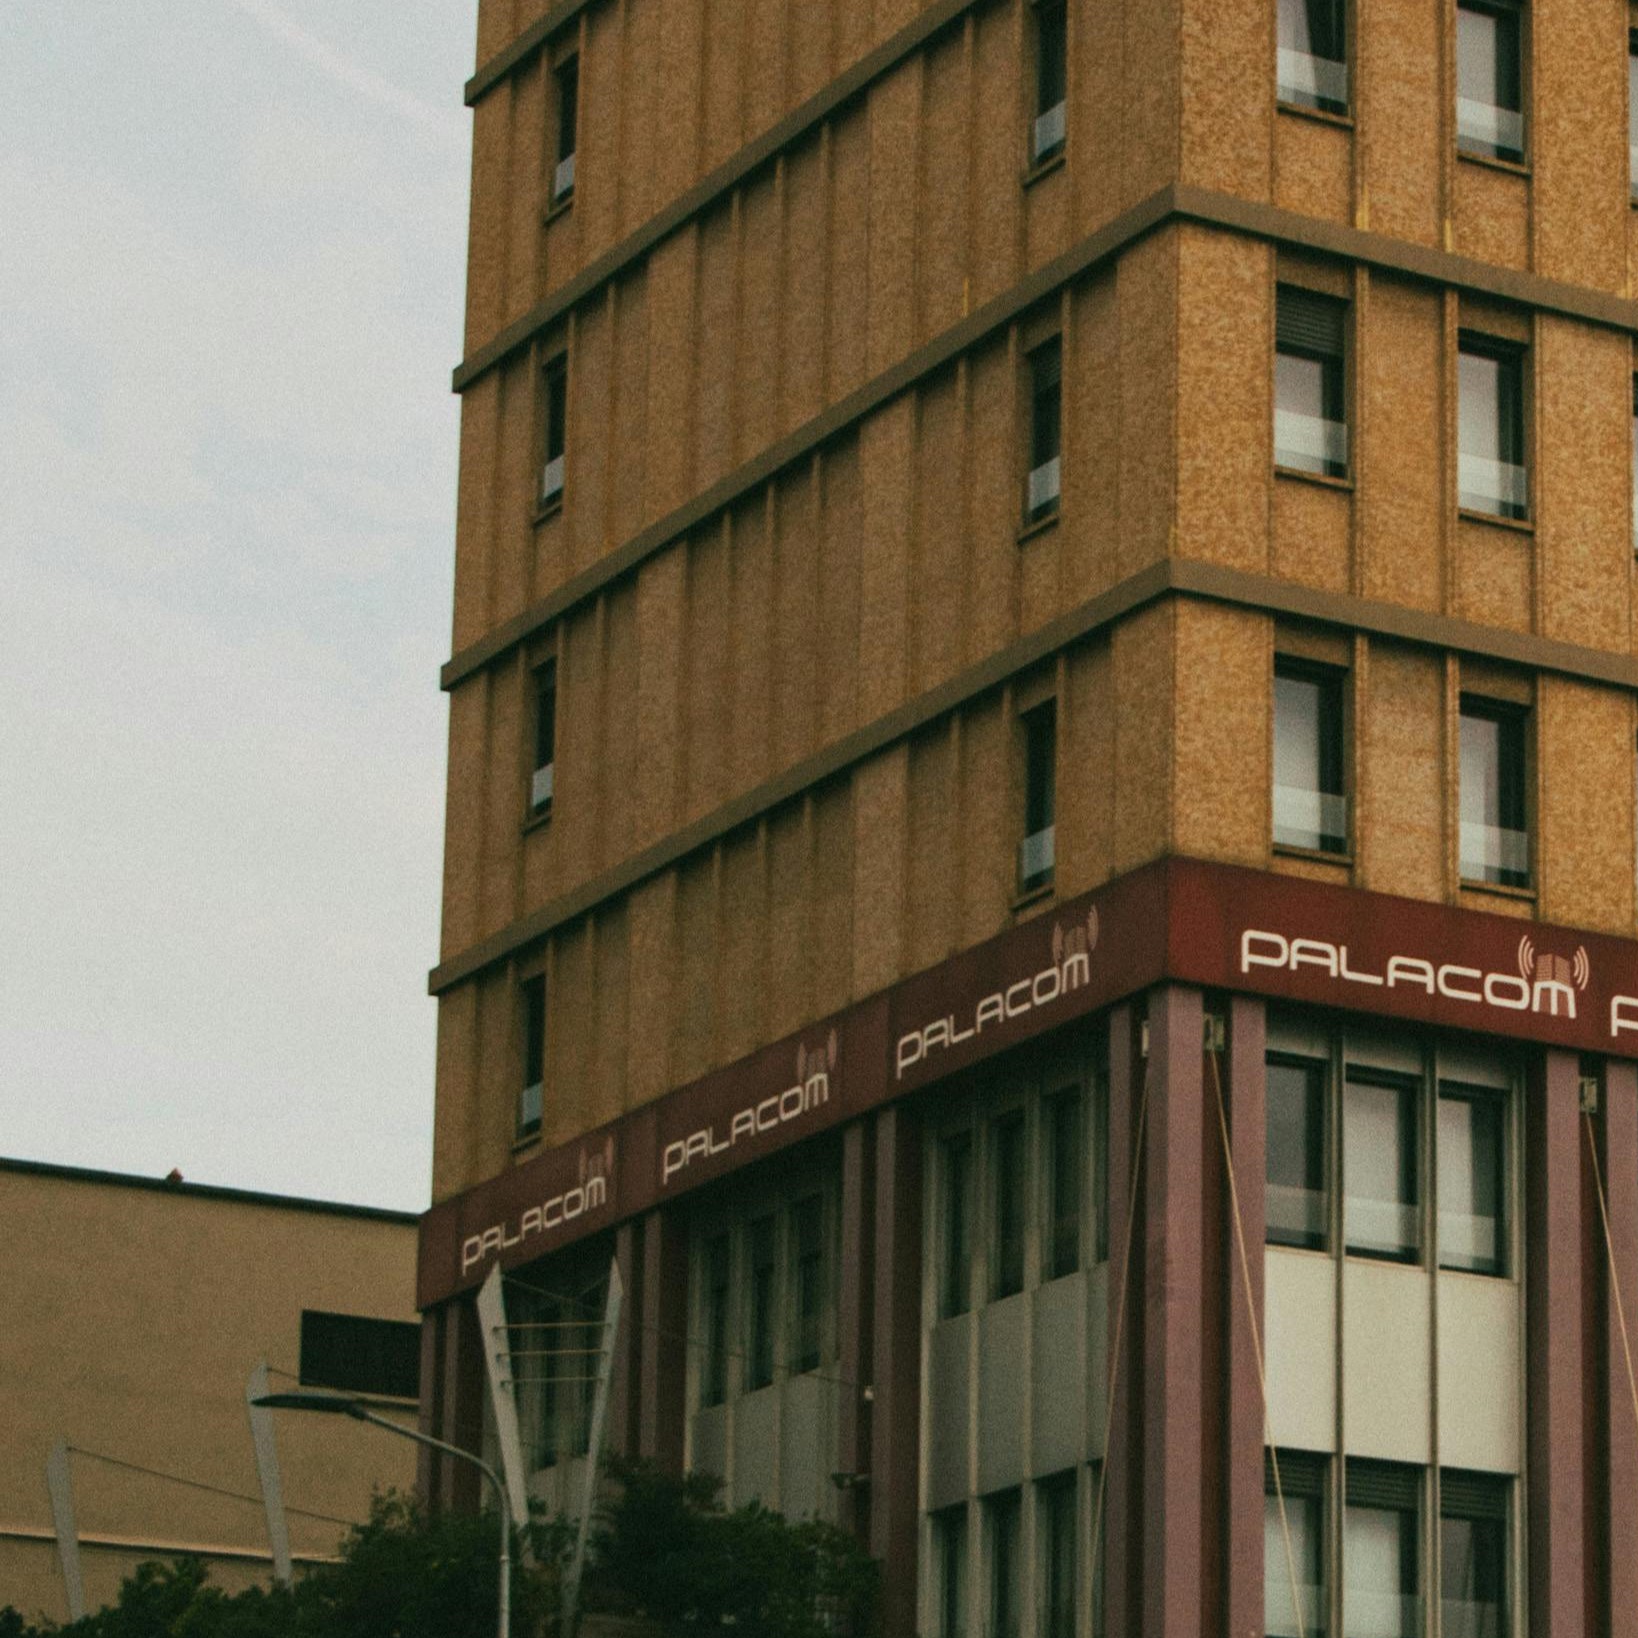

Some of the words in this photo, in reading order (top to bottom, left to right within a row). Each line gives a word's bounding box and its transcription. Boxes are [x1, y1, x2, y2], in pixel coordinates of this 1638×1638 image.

[895, 953, 1090, 1079] PALACOM
[1241, 929, 1577, 1019] PALACOM
[662, 1072, 830, 1184] PALACOM
[461, 1175, 606, 1277] PALACOM
